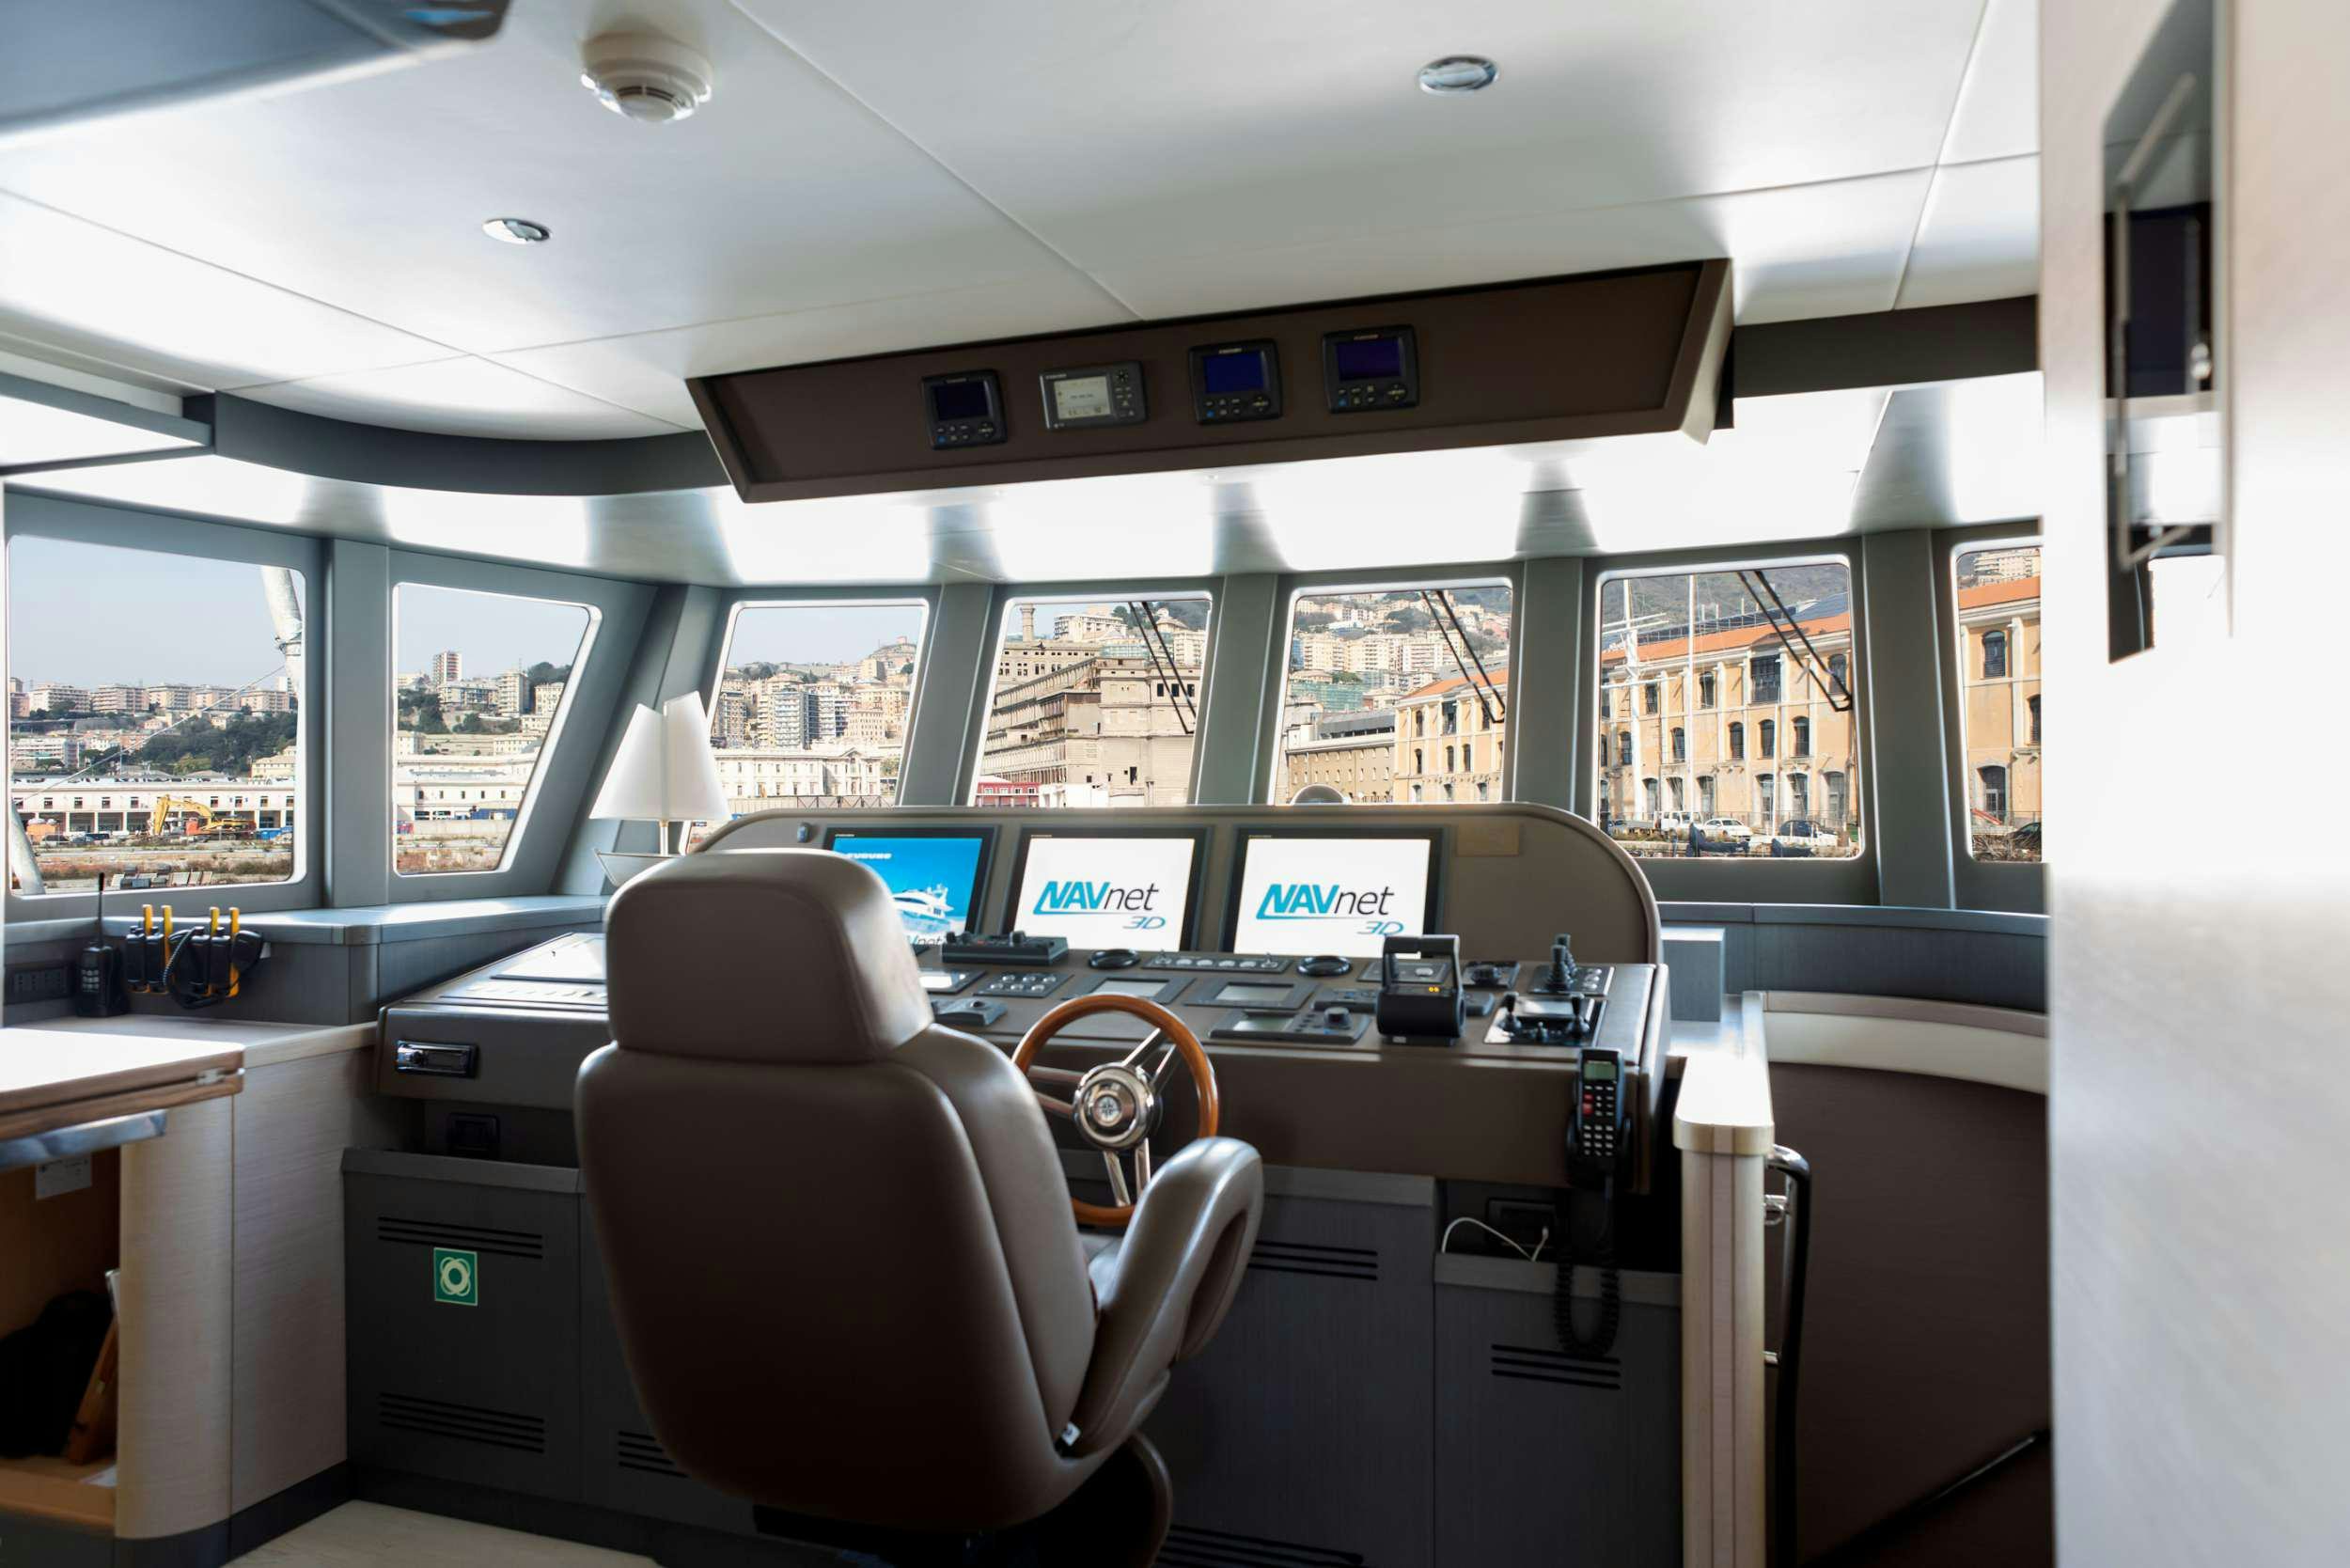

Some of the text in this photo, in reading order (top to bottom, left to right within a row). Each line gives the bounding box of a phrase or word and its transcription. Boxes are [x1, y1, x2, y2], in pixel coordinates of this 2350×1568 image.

[1033, 881, 1159, 915] NAVnet
[1256, 884, 1395, 919] NAVnet
[1122, 916, 1167, 930] 3D
[1356, 921, 1404, 935] 3D
